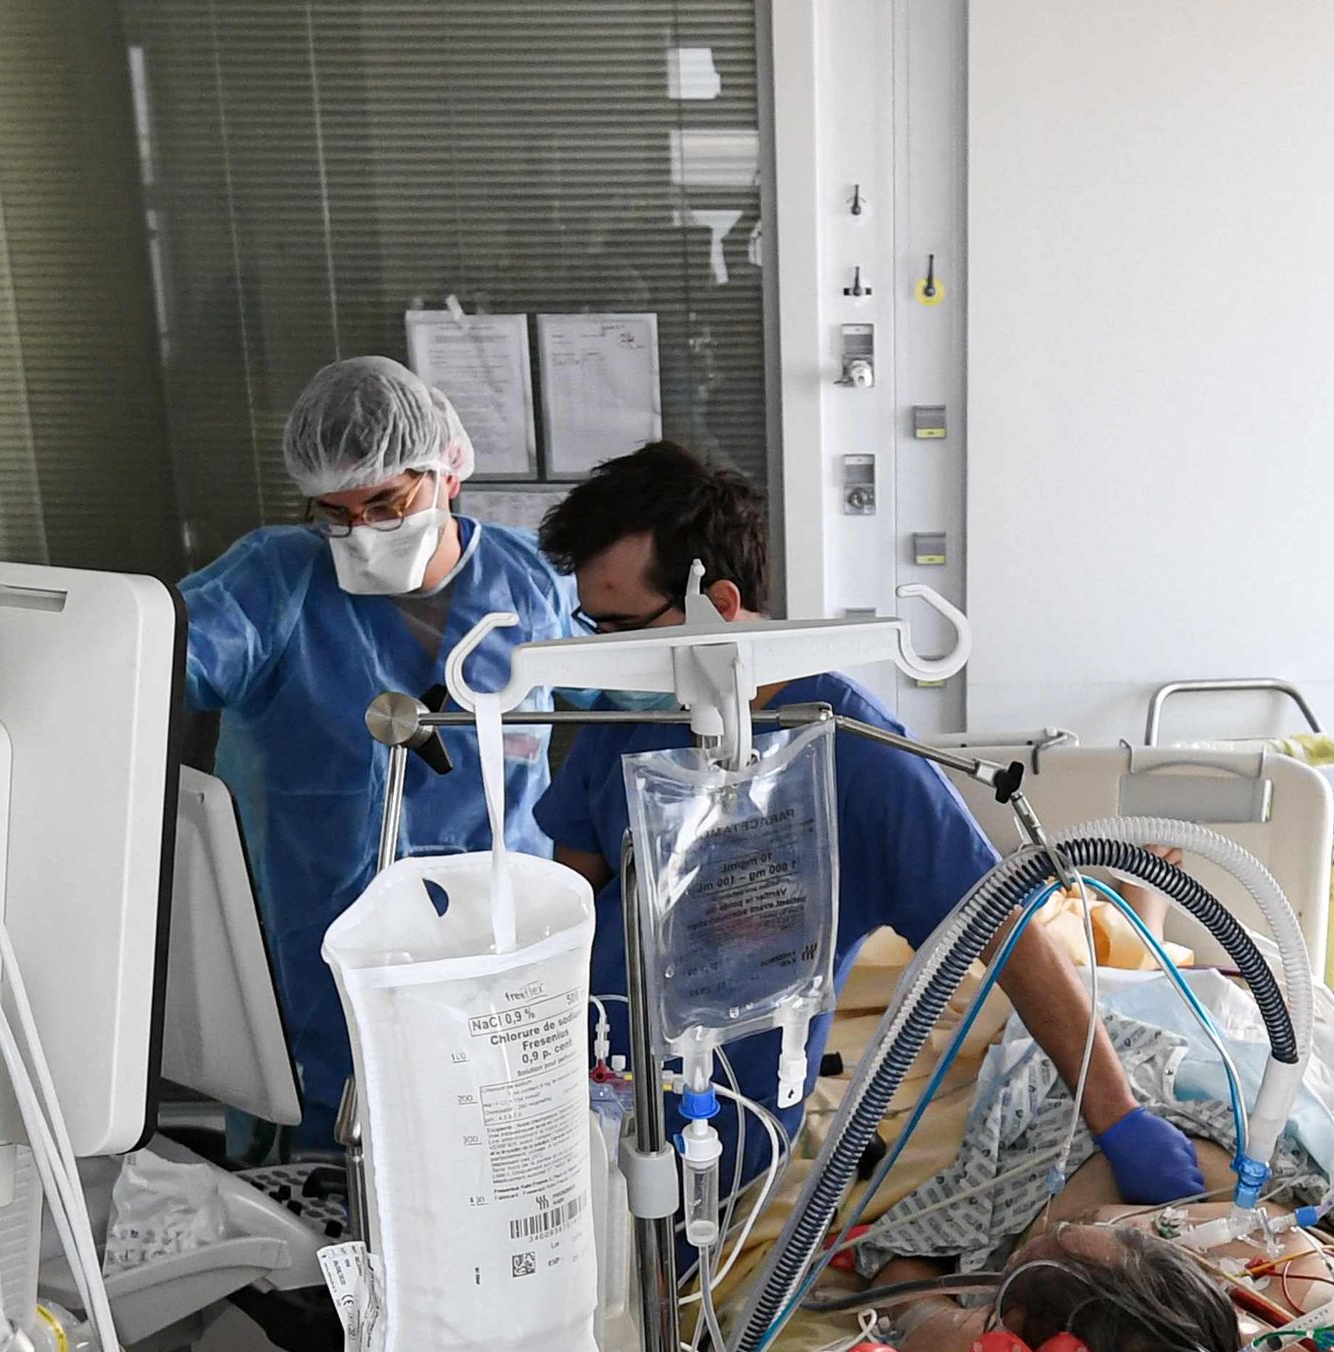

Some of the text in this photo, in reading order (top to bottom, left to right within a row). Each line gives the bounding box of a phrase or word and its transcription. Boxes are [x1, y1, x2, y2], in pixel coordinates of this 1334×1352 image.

[471, 1008, 535, 1032] NaCl 0,9 %
[490, 1026, 540, 1045] Chlorure
[543, 1021, 555, 1032] de
[522, 1029, 569, 1051] Fresenius
[521, 1050, 539, 1065] 0,9
